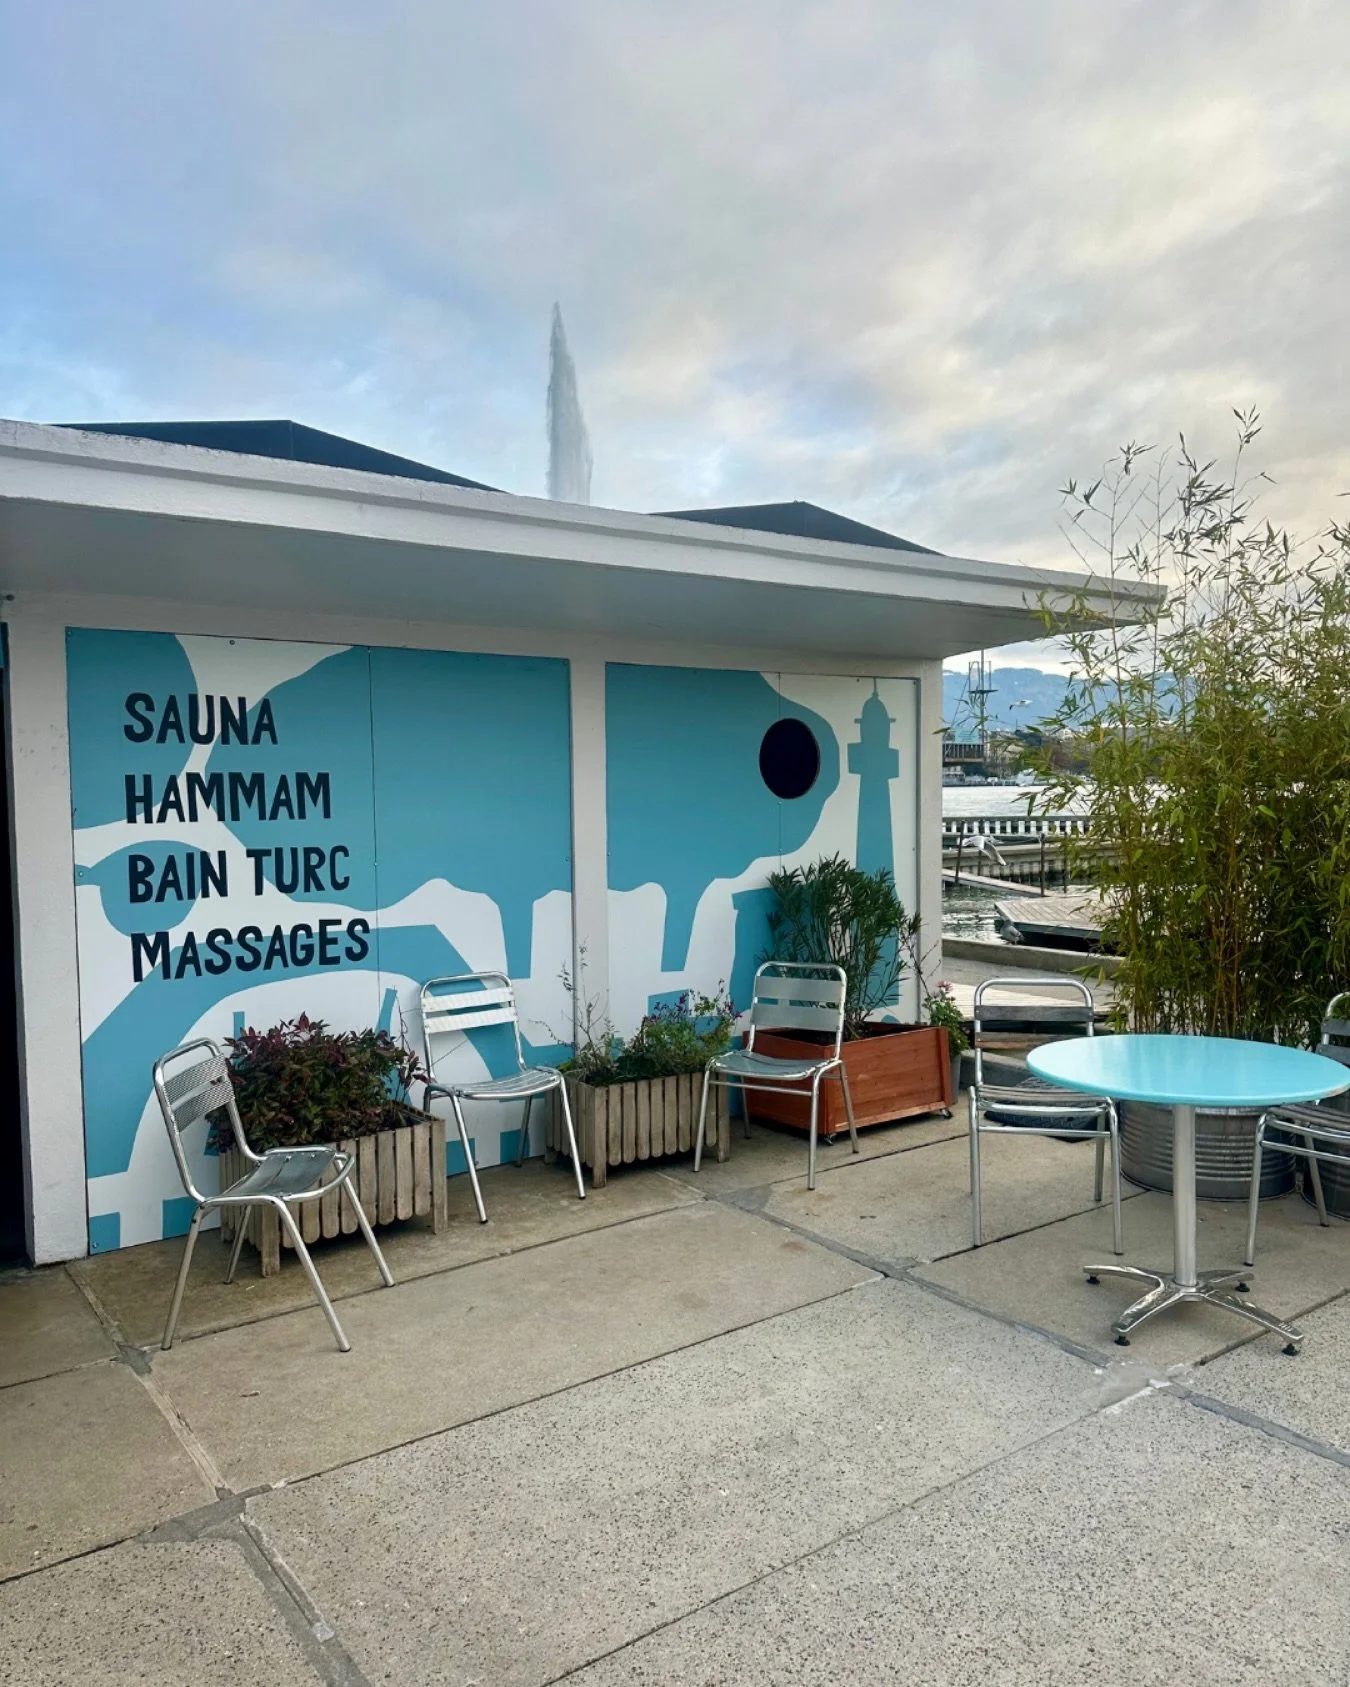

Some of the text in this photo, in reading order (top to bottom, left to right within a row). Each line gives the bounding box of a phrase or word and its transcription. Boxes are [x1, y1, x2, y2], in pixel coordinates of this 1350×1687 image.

[123, 692, 278, 745] SAUNA
[125, 771, 331, 823] HAMMAM
[128, 845, 350, 903] BAIN TURC
[131, 918, 371, 983] MASSAGES
